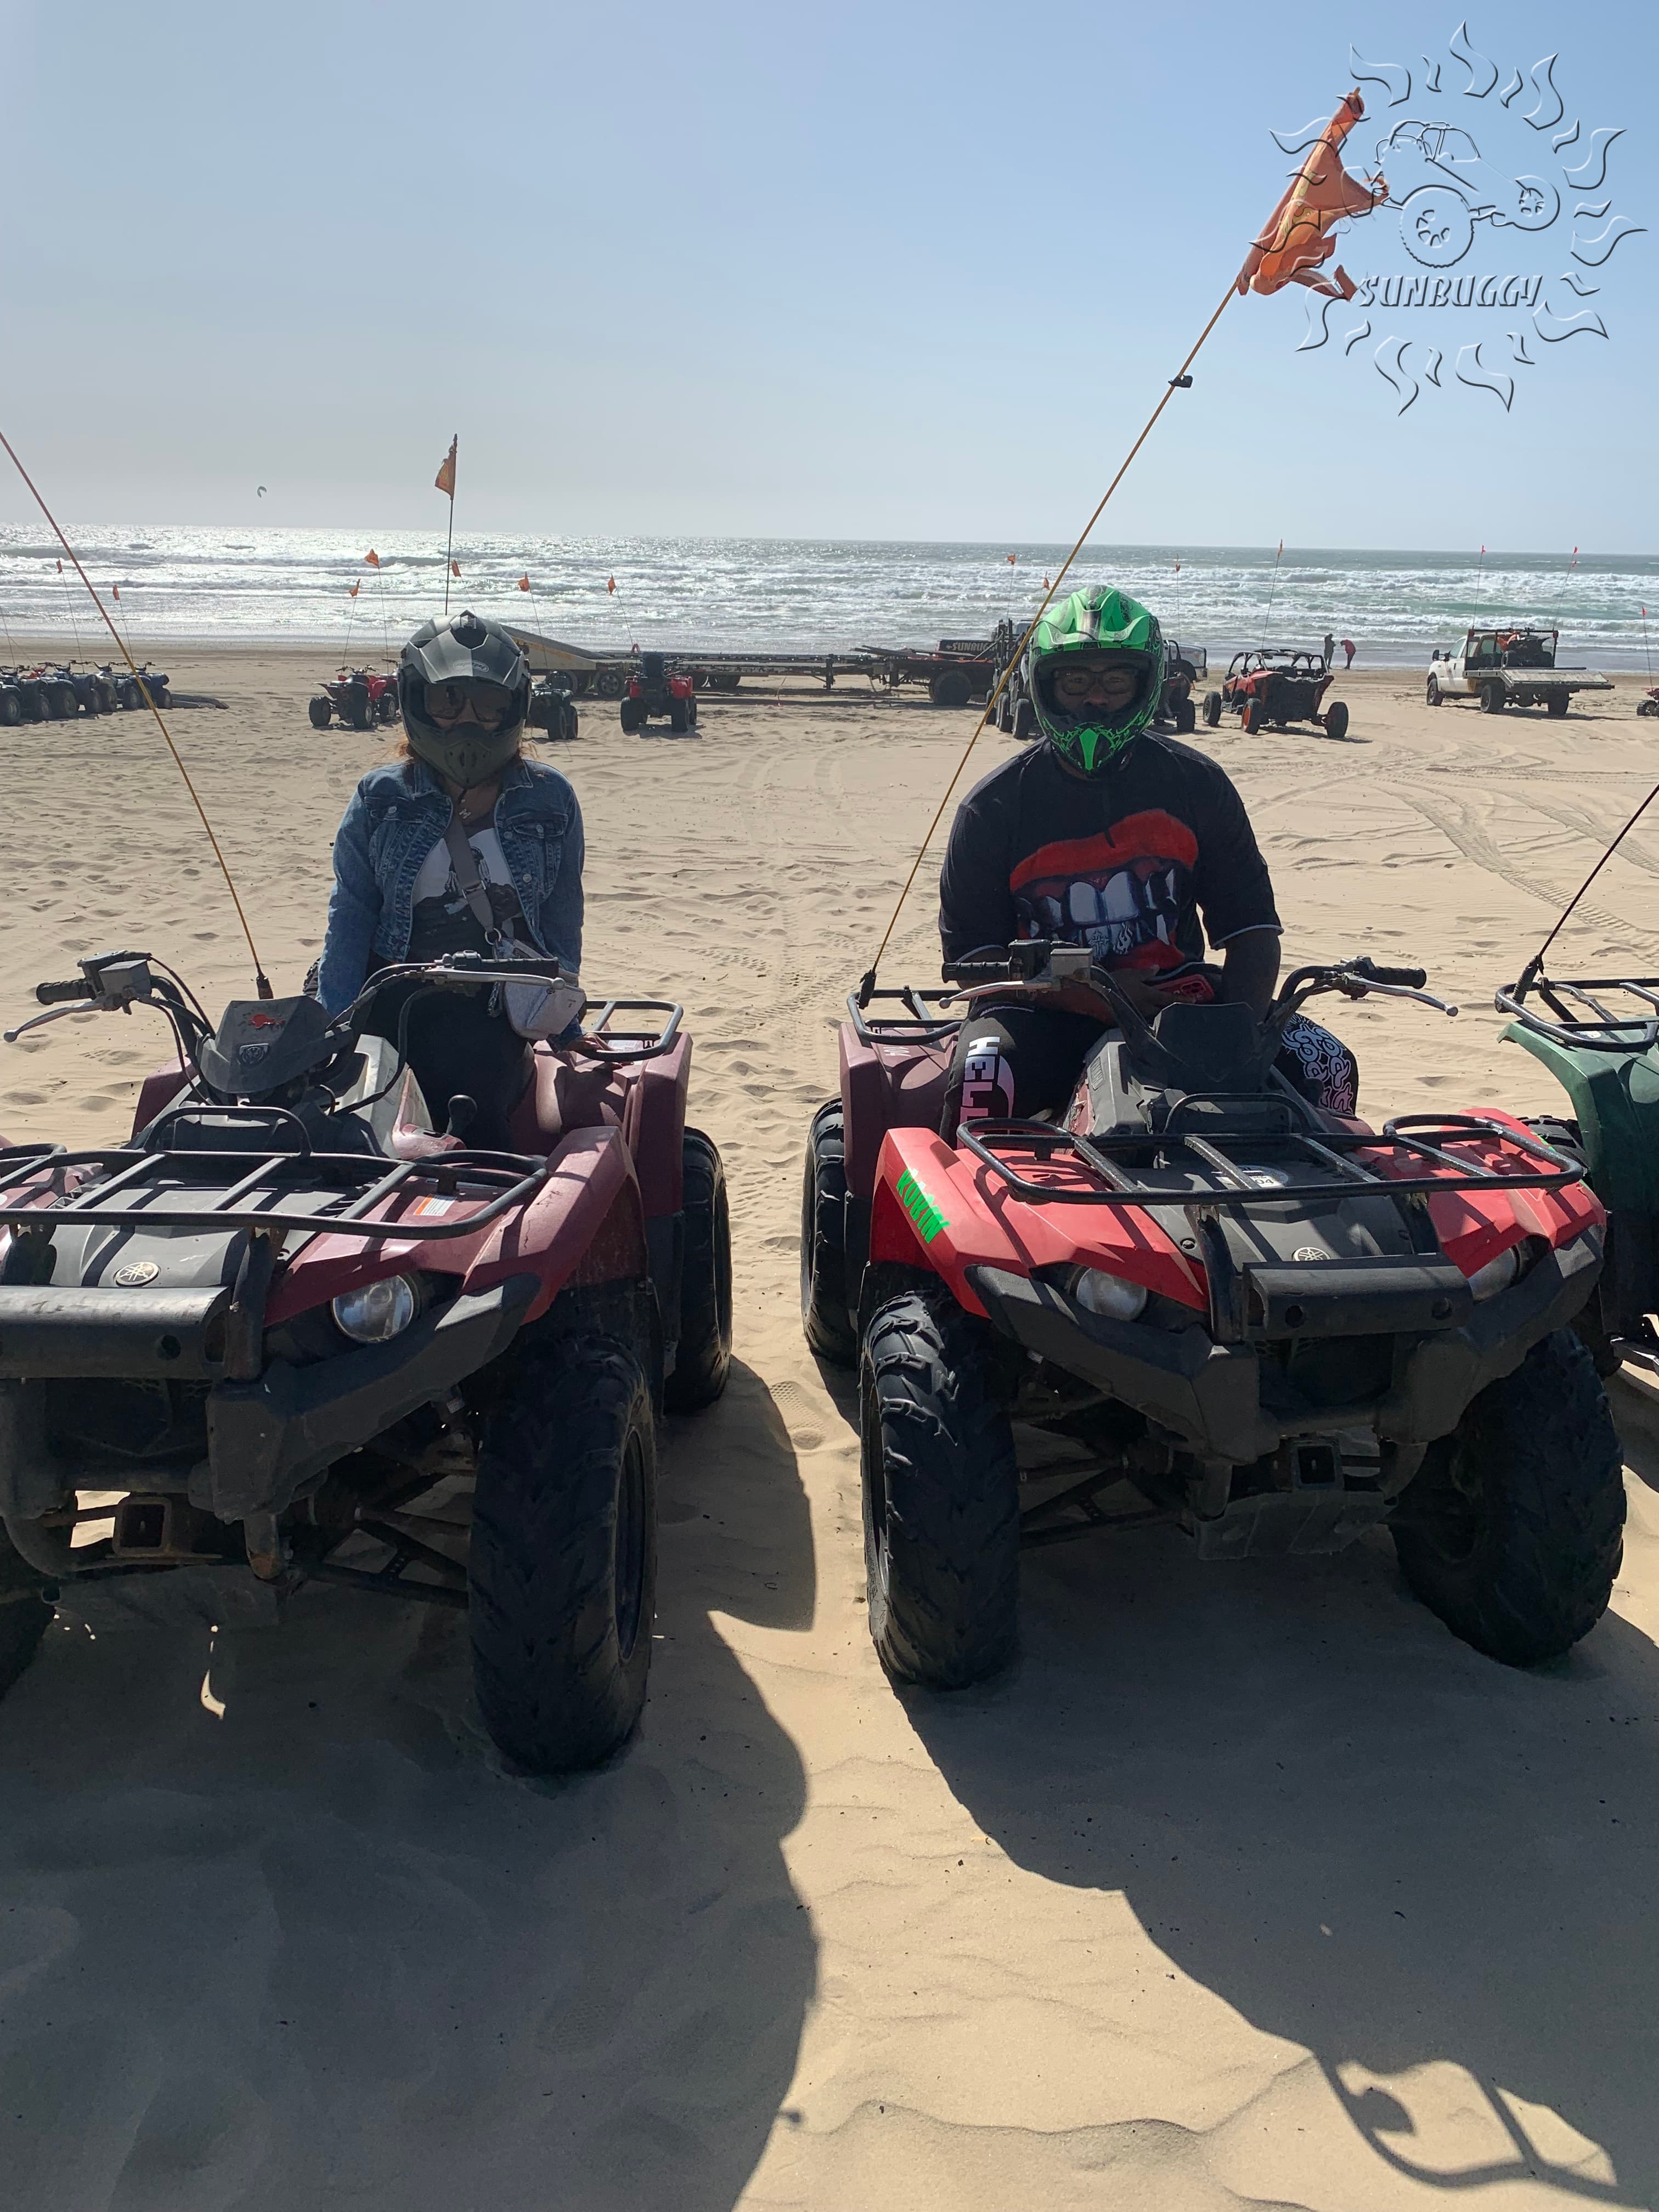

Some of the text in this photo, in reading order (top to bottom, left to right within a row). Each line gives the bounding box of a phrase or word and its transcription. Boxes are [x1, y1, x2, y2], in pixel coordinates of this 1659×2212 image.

[952, 642, 997, 651] SUNBUG
[883, 1046, 911, 1057] 104
[957, 1036, 1000, 1150] HELL
[896, 1167, 950, 1244] ROBIN
